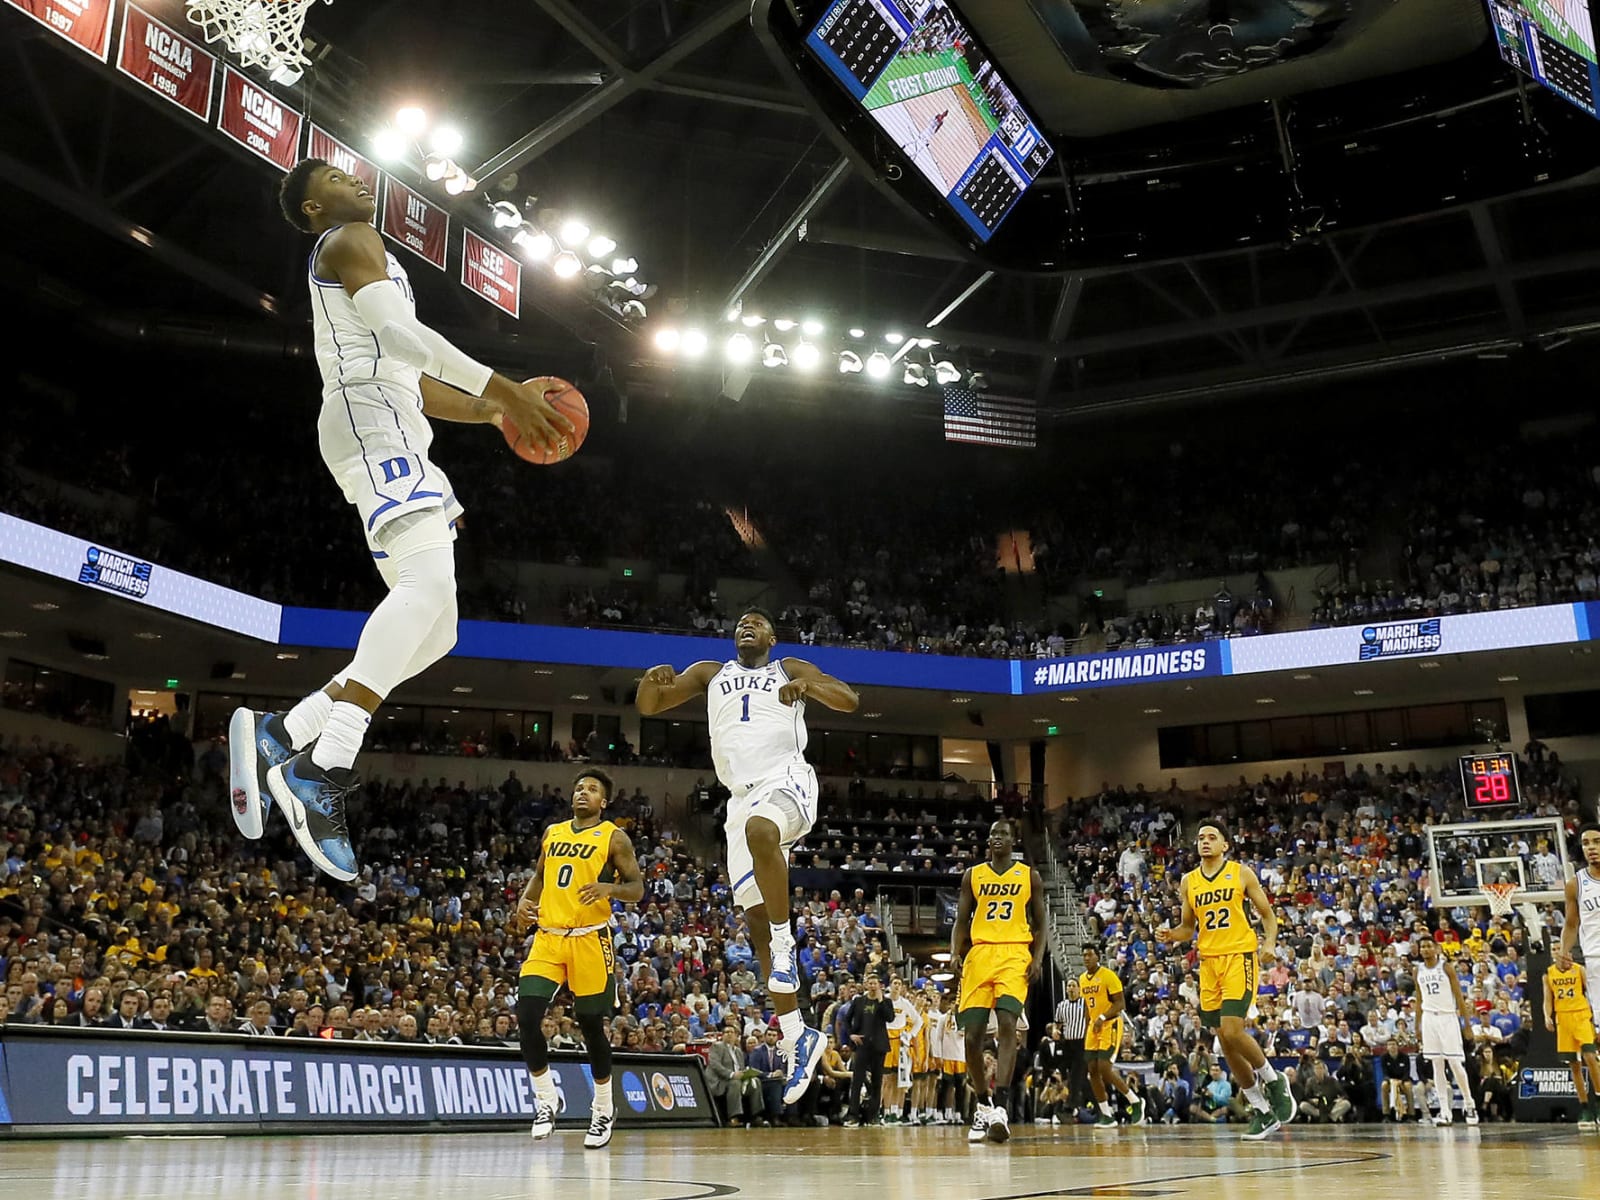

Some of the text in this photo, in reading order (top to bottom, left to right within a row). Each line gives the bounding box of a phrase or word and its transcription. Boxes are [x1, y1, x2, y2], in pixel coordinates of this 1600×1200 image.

[145, 22, 193, 73] NCAA
[148, 51, 187, 81] TOURNAMENT
[152, 71, 178, 97] 1998
[887, 65, 960, 100] FIRST ROUND
[240, 84, 283, 131] NCAA
[246, 131, 271, 154] 2004
[333, 146, 356, 176] NIT
[407, 194, 428, 225] NIT
[482, 247, 504, 276] SEC
[97, 551, 135, 576] MARCH
[99, 567, 149, 595] MADNESS
[1376, 624, 1419, 641] MARCH
[1382, 634, 1441, 652] MADNESS
[1034, 649, 1206, 686] #MARCHMADNESS
[720, 676, 776, 696] DUKE
[740, 694, 750, 722] 1
[1474, 774, 1509, 802] 28
[547, 842, 598, 859] NDSU
[556, 864, 574, 888] 0
[978, 884, 1022, 896] NDSU
[1194, 888, 1235, 908] NDSU
[986, 901, 1014, 922] 23
[1205, 908, 1230, 930] 22
[1082, 985, 1100, 994] NDSU
[1419, 974, 1445, 984] DUKE
[1426, 983, 1440, 996] 12
[1552, 977, 1577, 987] NDSU
[1089, 998, 1096, 1008] 3
[1557, 988, 1575, 1000] 24
[67, 1055, 297, 1115] CELEBRATE
[304, 1061, 426, 1115] MARCH
[1533, 1070, 1569, 1082] MARCH
[626, 1091, 647, 1102] NCAA
[671, 1084, 694, 1097] WILD
[675, 1097, 697, 1108] WINGS
